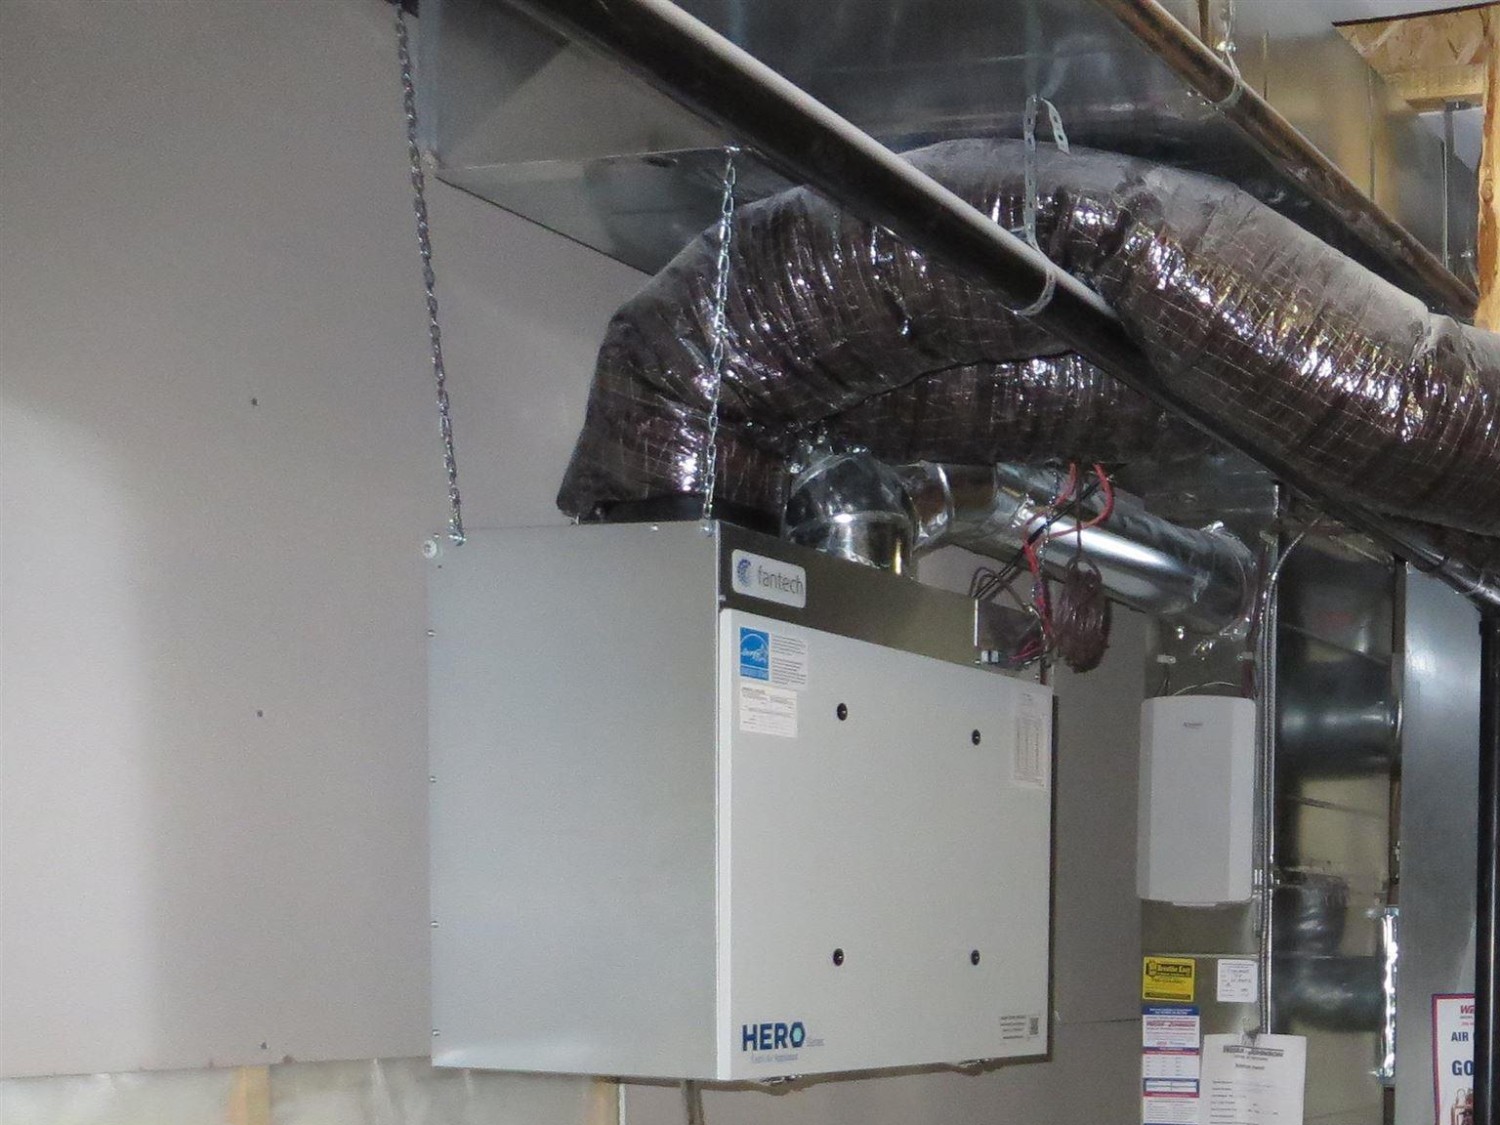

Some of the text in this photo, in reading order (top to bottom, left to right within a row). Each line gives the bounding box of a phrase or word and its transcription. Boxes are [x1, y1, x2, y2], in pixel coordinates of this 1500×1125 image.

[757, 565, 804, 594] fantech
[742, 1021, 806, 1052] HERO
[1451, 1031, 1469, 1042] AIR
